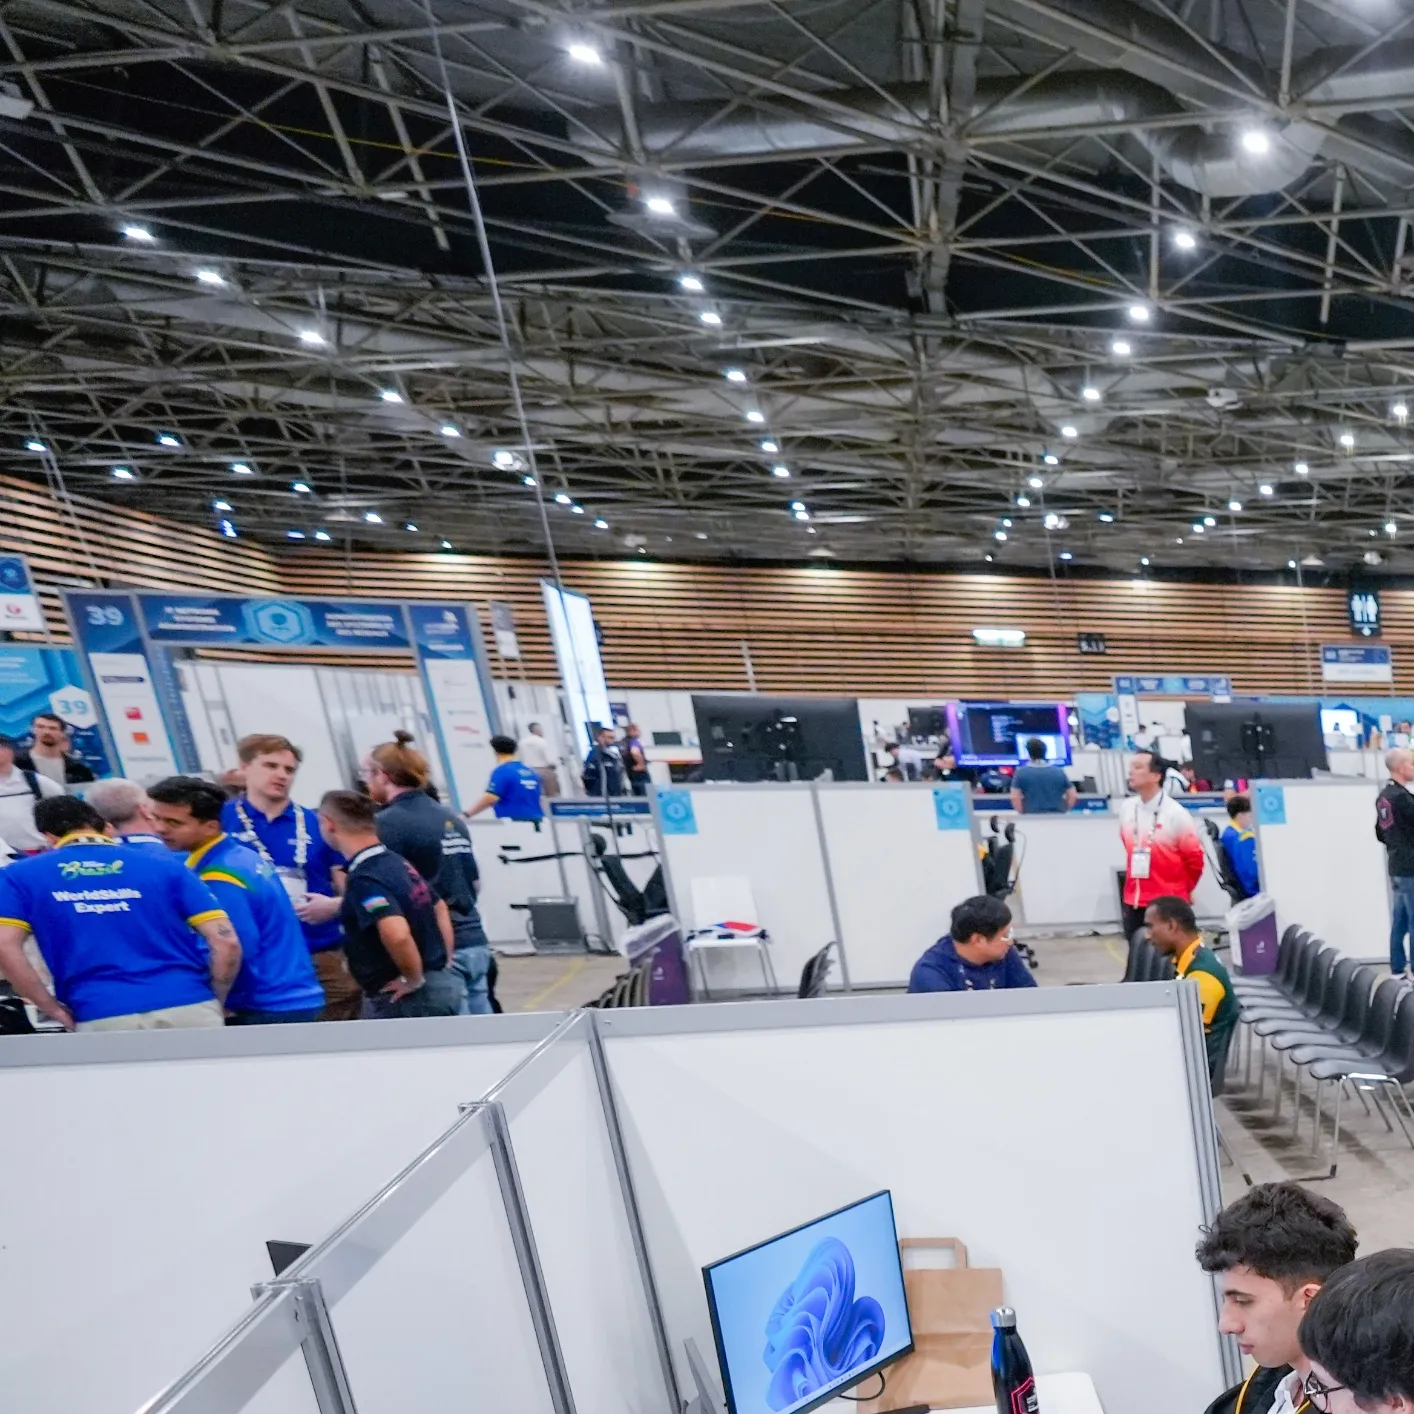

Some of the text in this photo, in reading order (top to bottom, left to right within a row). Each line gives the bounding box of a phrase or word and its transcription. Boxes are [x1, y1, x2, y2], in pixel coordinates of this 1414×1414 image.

[85, 605, 124, 626] 39
[58, 699, 88, 715] 39
[52, 888, 142, 901] WorldSkills
[74, 901, 131, 914] Expert
